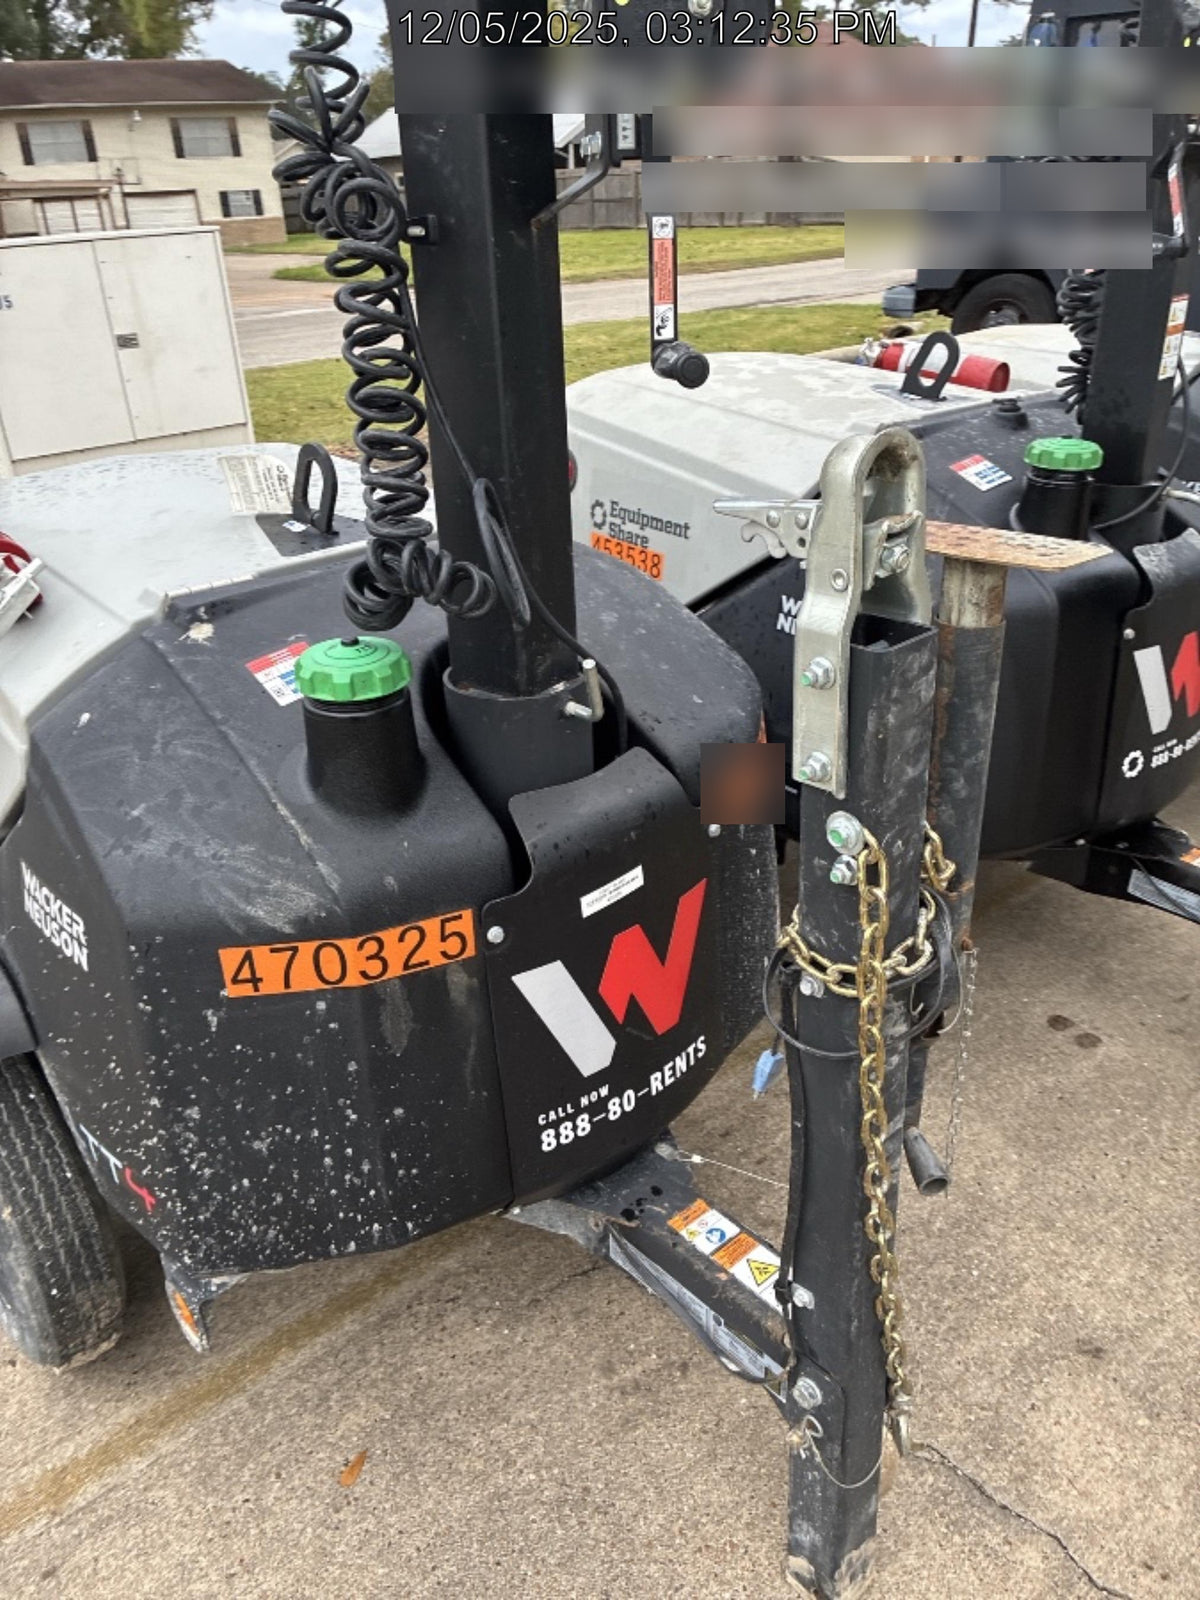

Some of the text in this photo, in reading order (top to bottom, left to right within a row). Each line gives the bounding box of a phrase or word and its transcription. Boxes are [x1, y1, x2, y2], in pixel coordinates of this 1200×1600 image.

[608, 499, 691, 540] Equipment
[608, 521, 650, 549] Share
[20, 860, 88, 947] WACKER
[24, 887, 89, 972] NEUSON
[230, 913, 469, 993] 470325
[537, 1084, 611, 1126] CALL NOW
[540, 1035, 708, 1153] 888-80-RENTS
